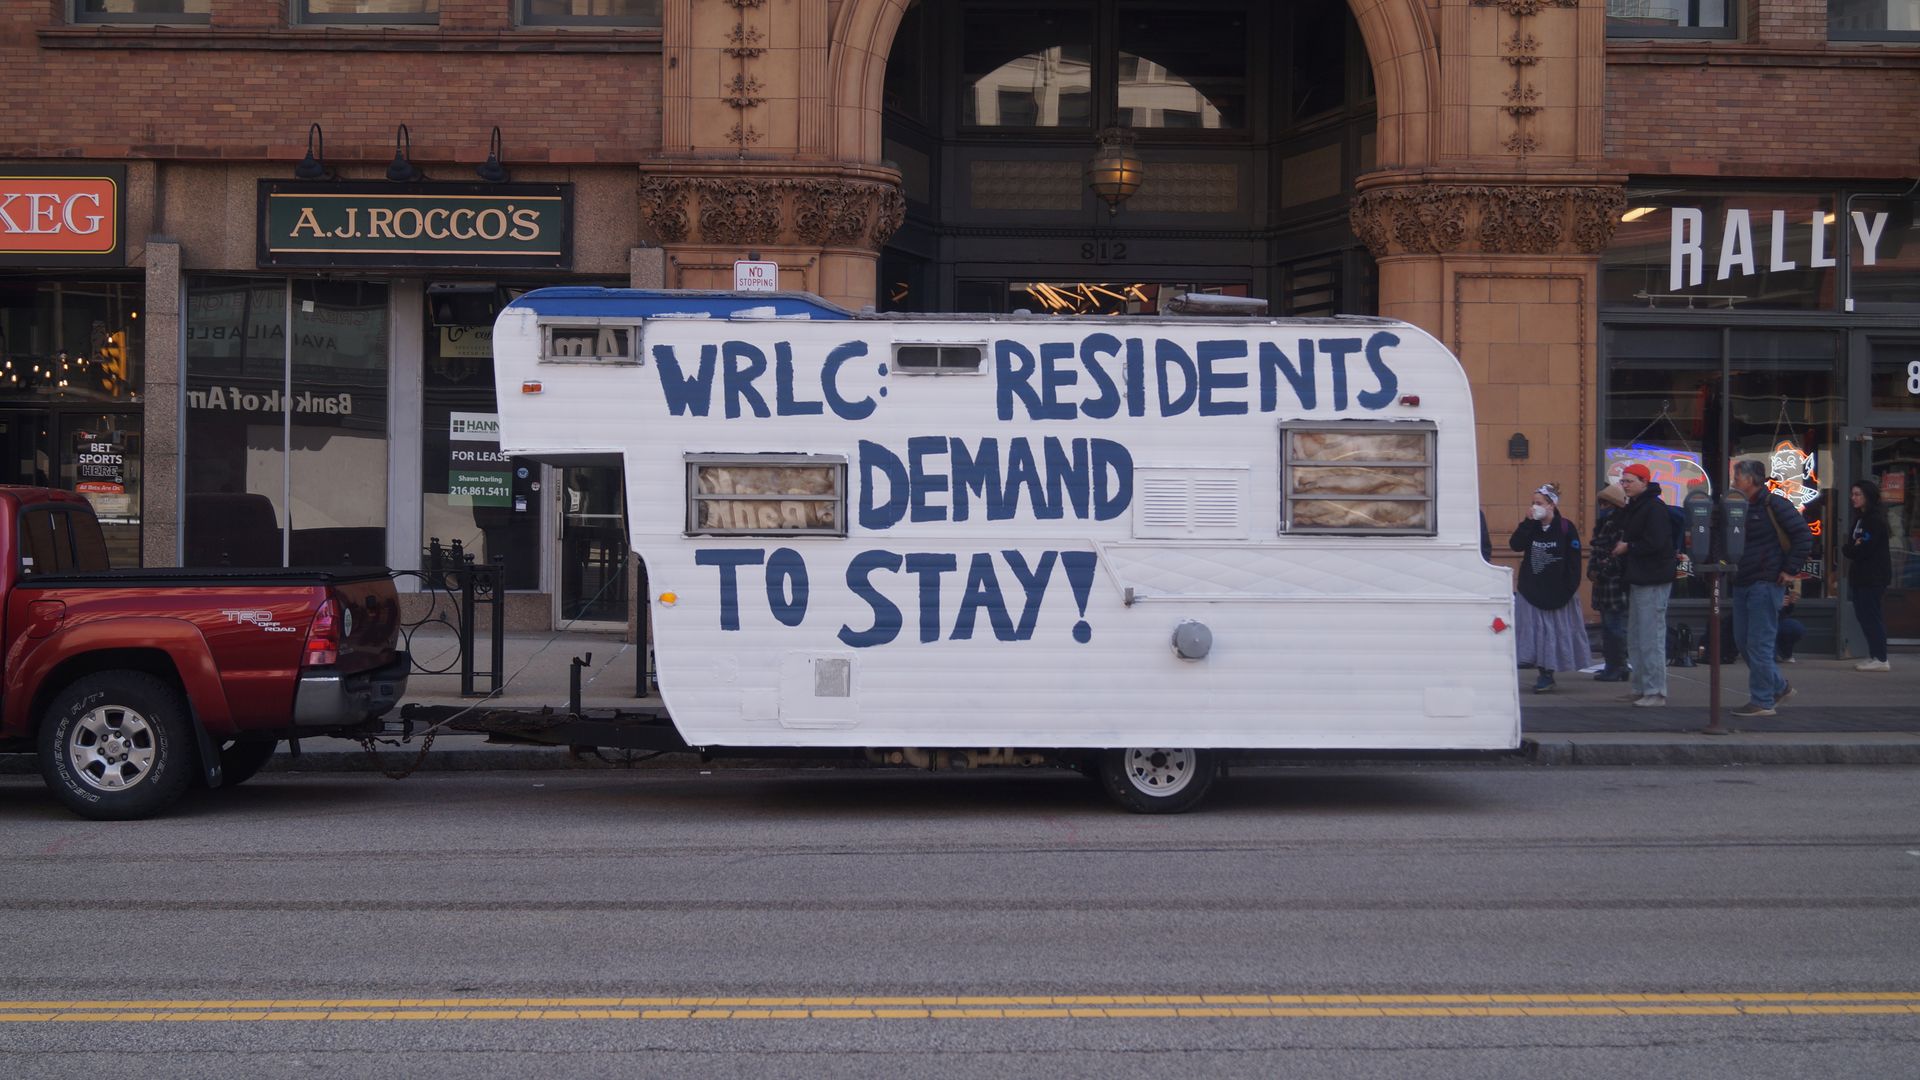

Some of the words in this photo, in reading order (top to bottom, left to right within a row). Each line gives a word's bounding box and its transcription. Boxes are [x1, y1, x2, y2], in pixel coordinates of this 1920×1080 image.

[0, 193, 105, 234] KEG
[367, 204, 541, 241] ROCCO'S
[1081, 242, 1128, 260] 812
[1669, 207, 1889, 292] RALLY
[749, 267, 763, 278] NO
[739, 278, 774, 287] STOPPING
[651, 339, 889, 420] WRLC:
[994, 331, 1401, 421] RESIDENTS
[90, 443, 113, 453] BET
[79, 454, 123, 464] SPORTS
[452, 451, 475, 461] FOR
[476, 451, 511, 462] LEASE
[82, 465, 118, 476] HERE
[479, 475, 503, 484] Darling
[858, 435, 1134, 530] DEMAND
[450, 486, 510, 496] 216.861.5411
[1733, 526, 1740, 534] A
[695, 546, 809, 632] TO
[837, 549, 1098, 649] STAY!
[222, 610, 273, 625] TRD
[53, 717, 101, 802] DISCOVERER
